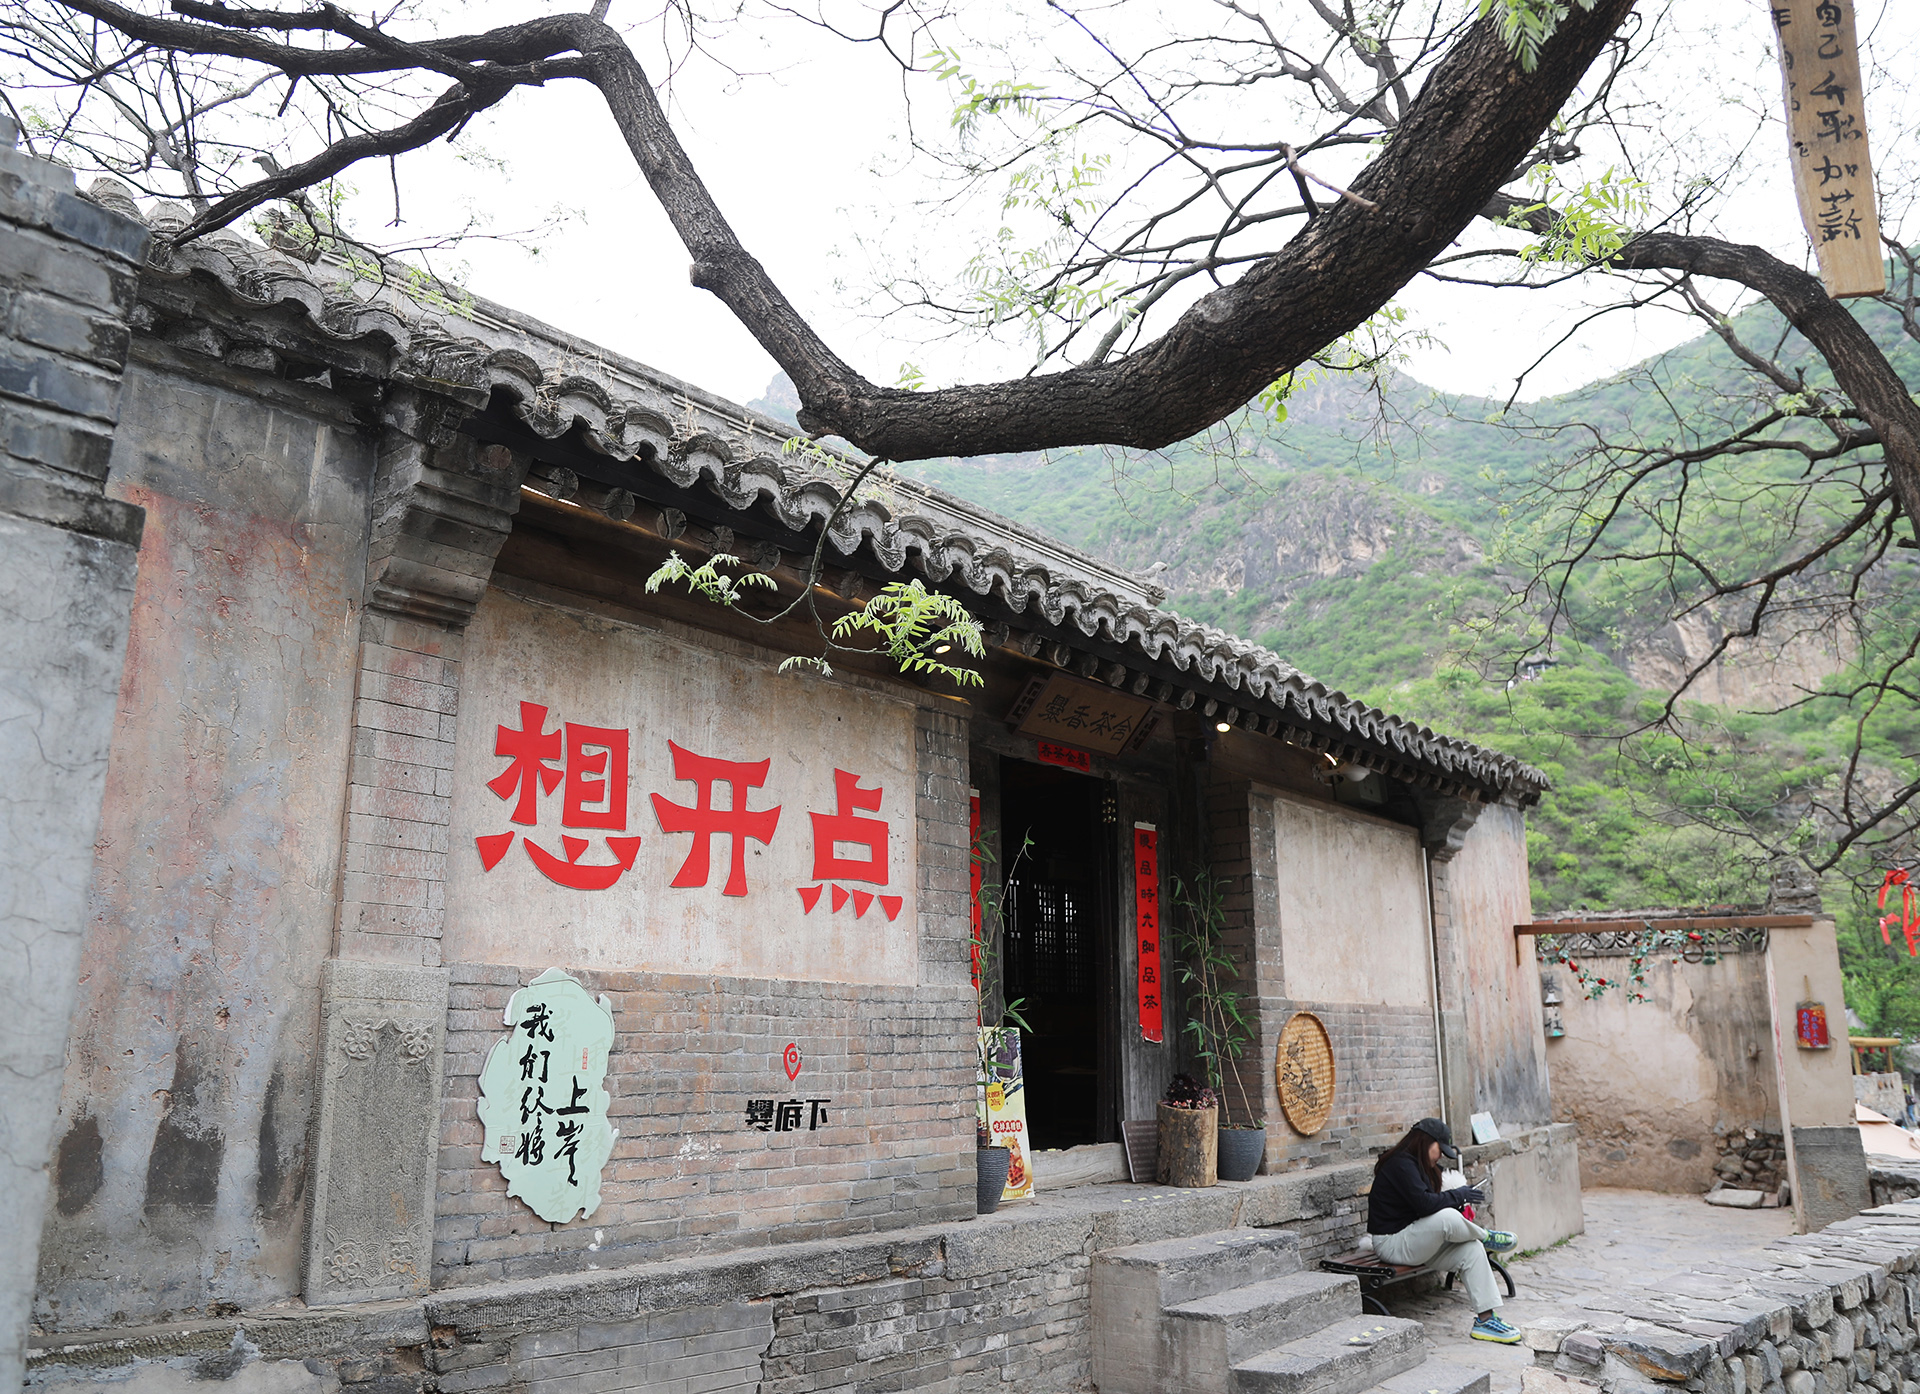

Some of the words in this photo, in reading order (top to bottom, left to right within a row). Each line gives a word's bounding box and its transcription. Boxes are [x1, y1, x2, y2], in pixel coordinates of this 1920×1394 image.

[475, 701, 903, 921] 想开点
[515, 1002, 555, 1166] 我们终将
[554, 1075, 589, 1186] 上岸
[745, 1098, 831, 1131] 爨底下
